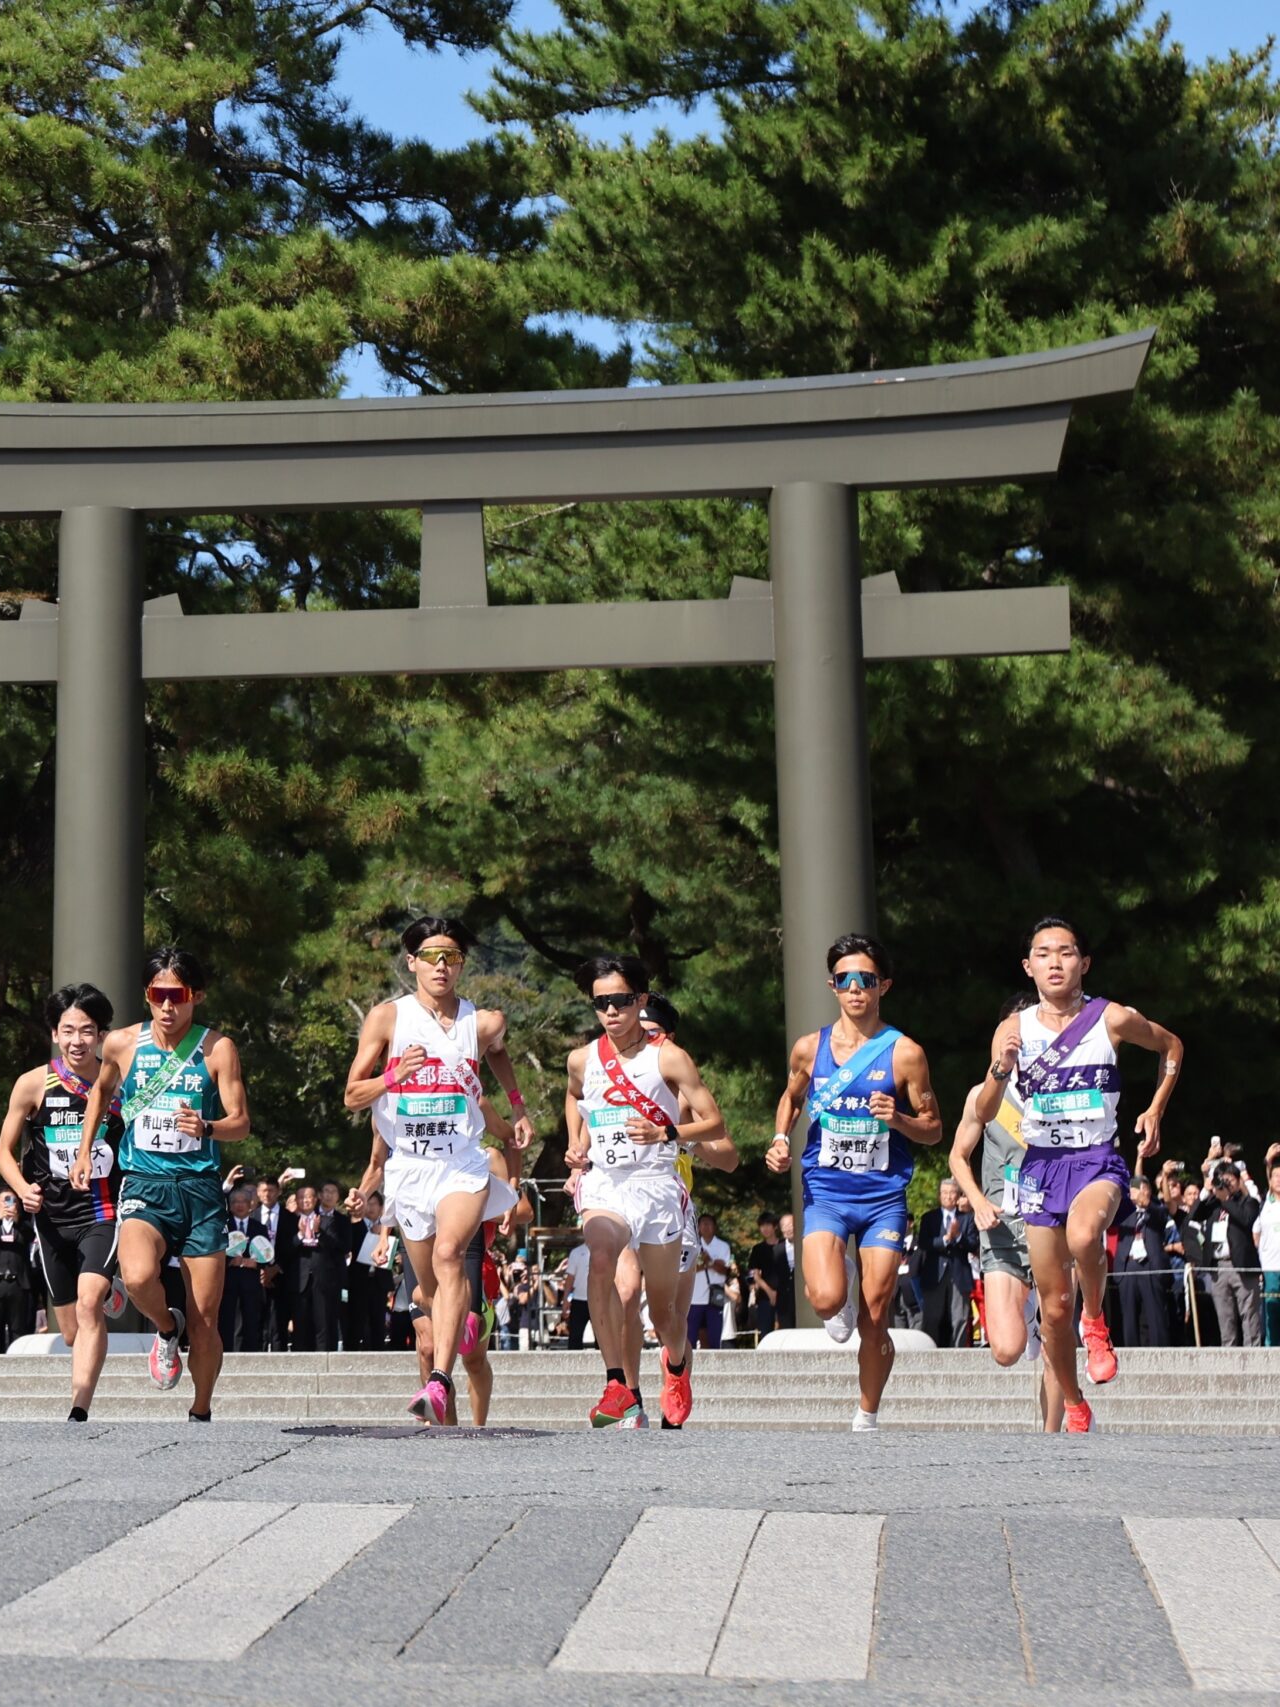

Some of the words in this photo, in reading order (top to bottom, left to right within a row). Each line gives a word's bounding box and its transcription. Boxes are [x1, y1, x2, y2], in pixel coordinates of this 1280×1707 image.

[406, 1099, 456, 1115] 前田道路
[405, 1120, 459, 1137] 京都産業大
[828, 1118, 879, 1133] 前田道路
[55, 1128, 84, 1141] 前田
[151, 1134, 182, 1151] 4-1
[1050, 1129, 1084, 1146] 5-1
[411, 1140, 453, 1155] 17-1
[606, 1149, 638, 1165] 8-1
[830, 1156, 876, 1170] 20-1
